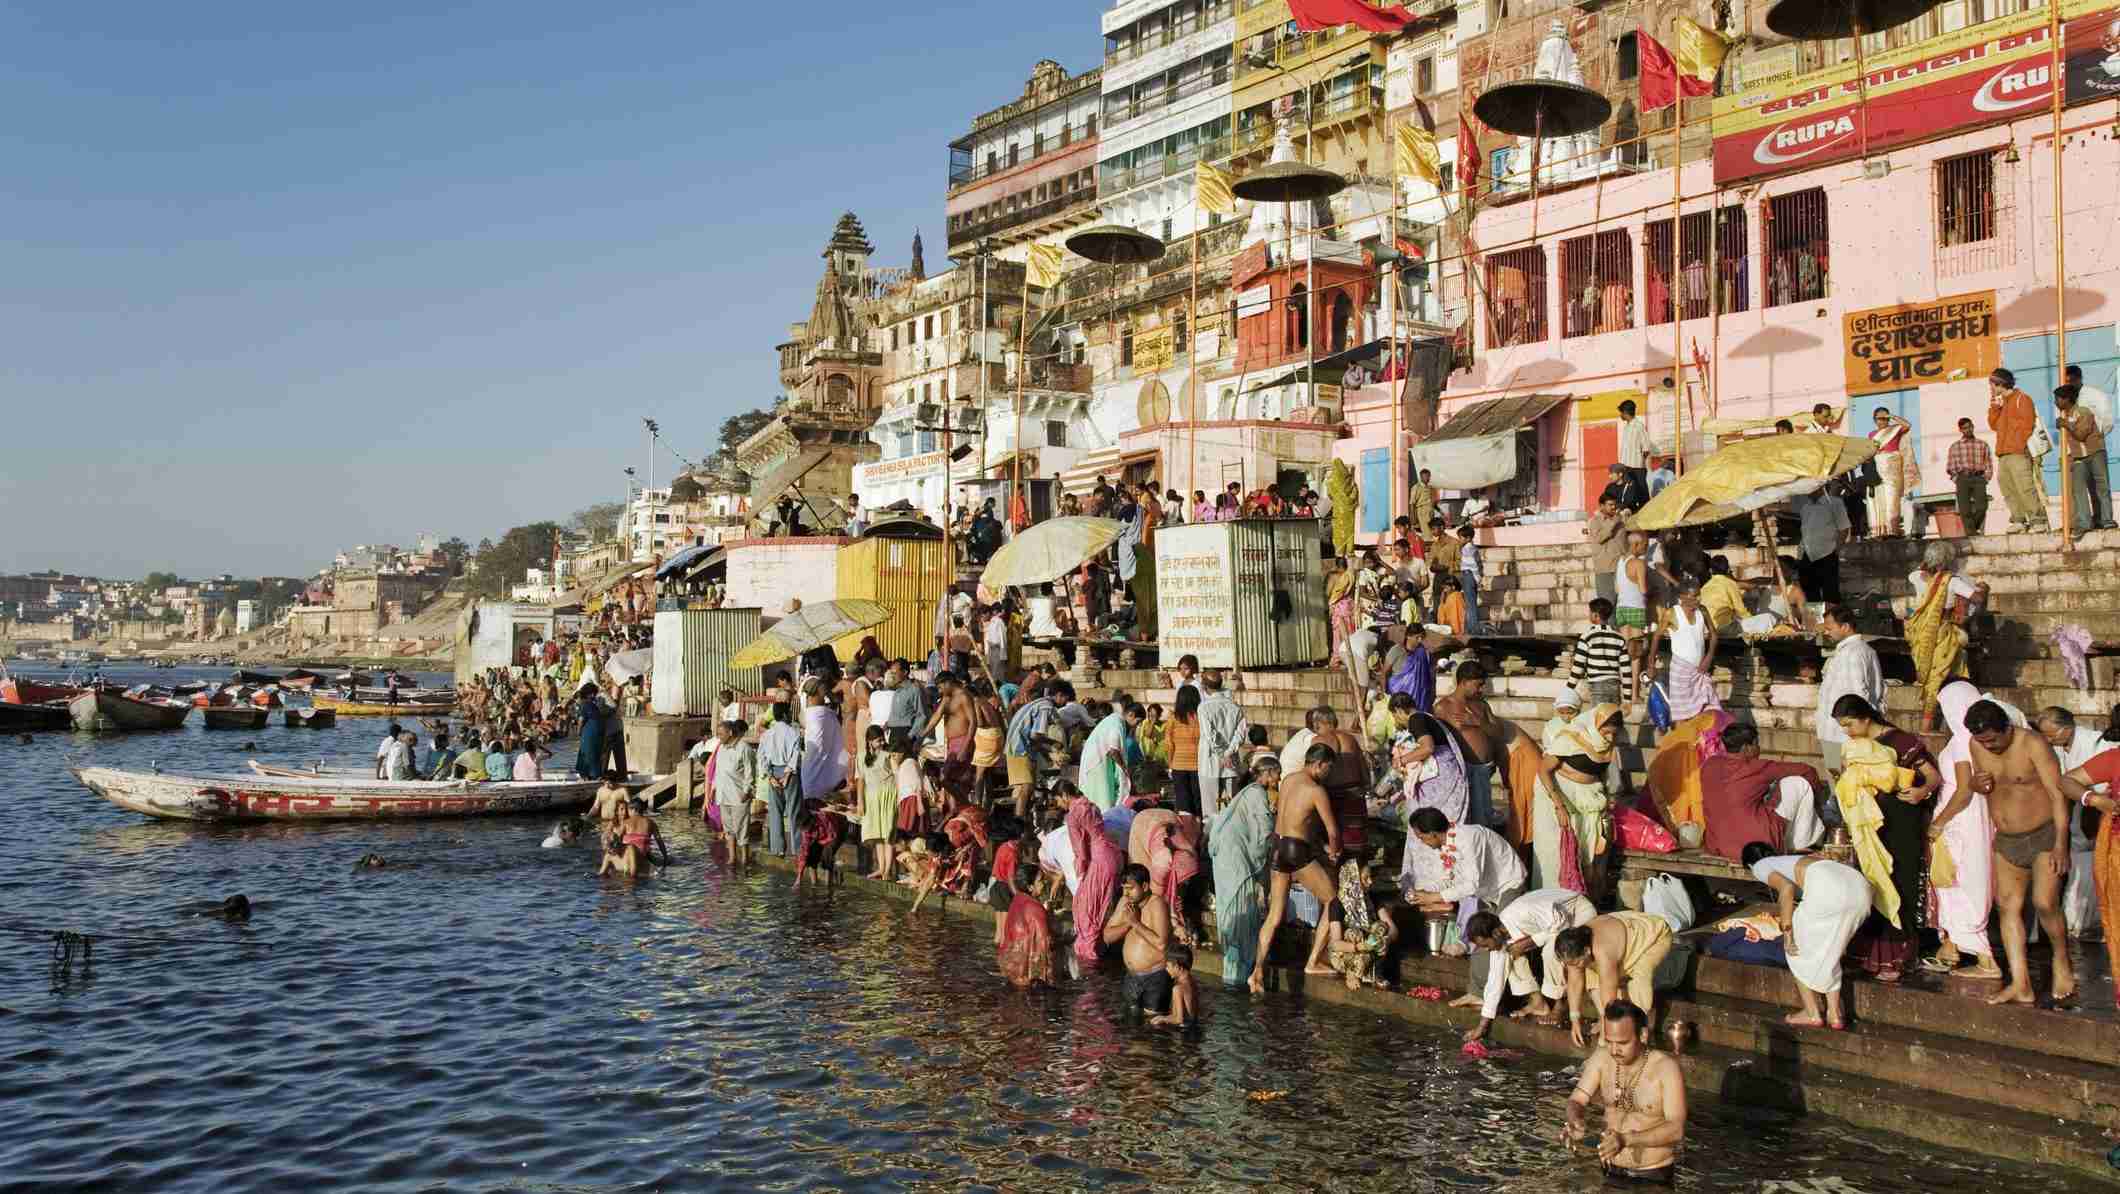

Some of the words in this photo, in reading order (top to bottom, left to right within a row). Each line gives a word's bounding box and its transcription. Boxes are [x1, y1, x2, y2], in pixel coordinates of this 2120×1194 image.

[1775, 114, 1856, 149] RUPA
[1851, 314, 1992, 359] दशाश्वमेध
[1868, 350, 1946, 383] घाट
